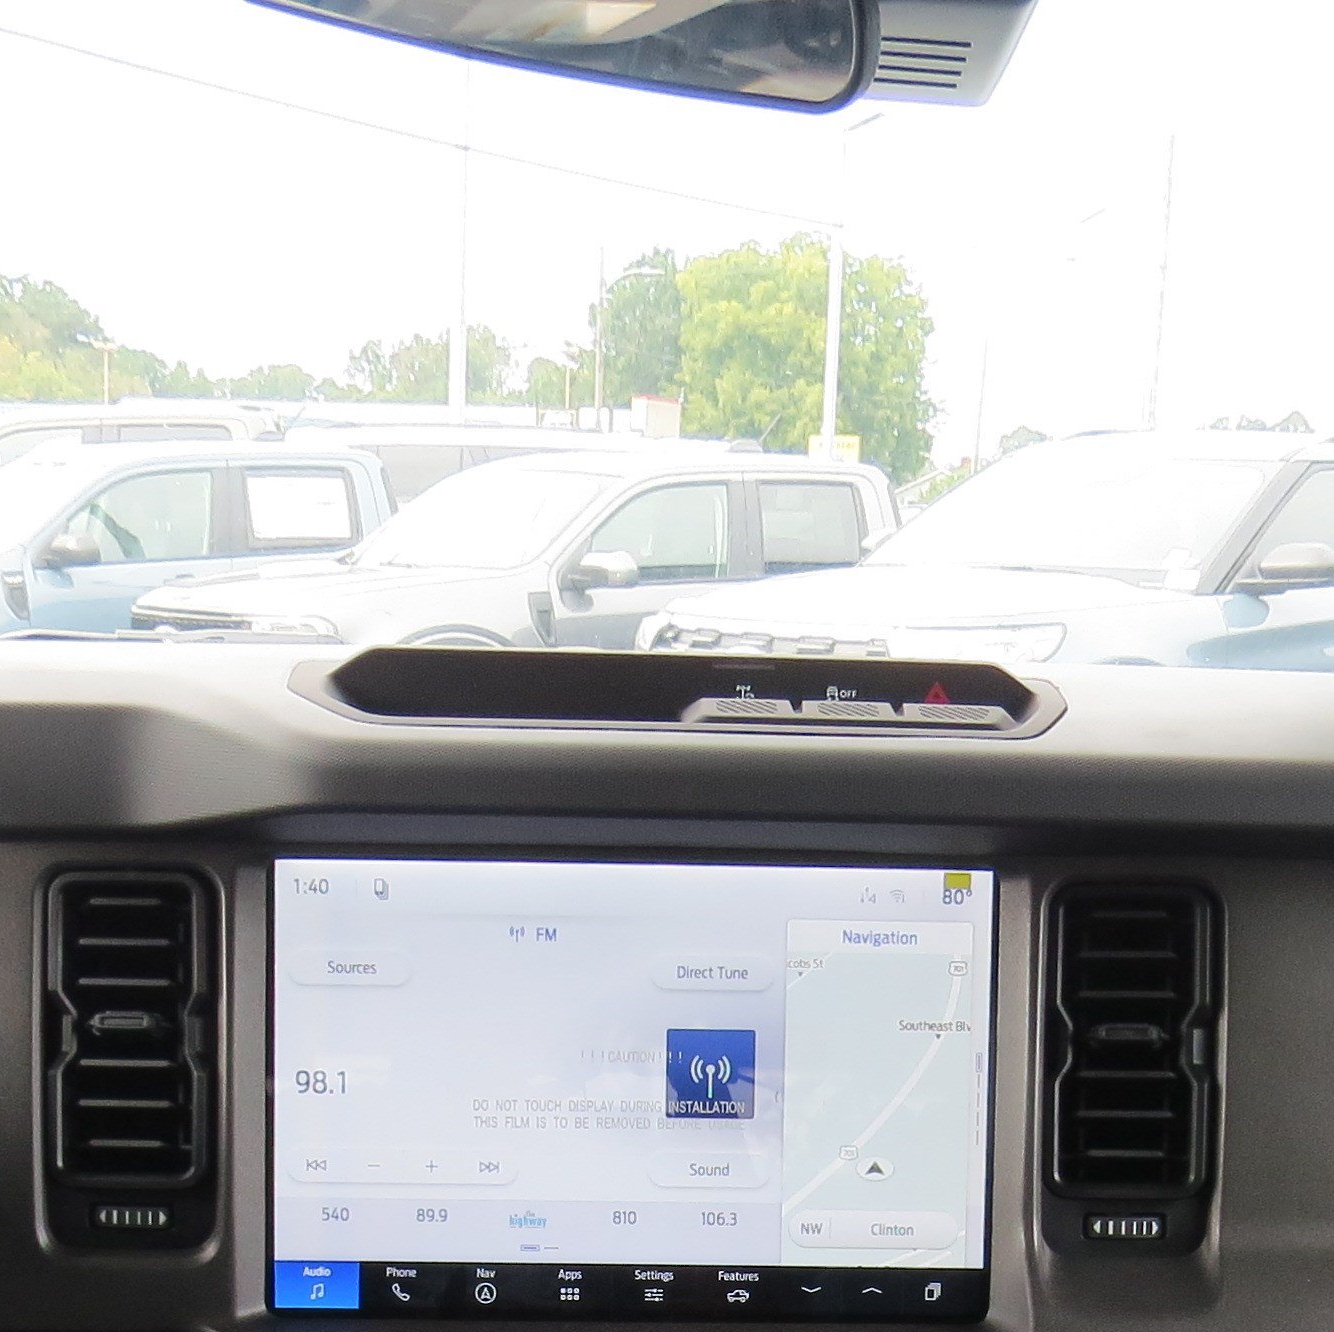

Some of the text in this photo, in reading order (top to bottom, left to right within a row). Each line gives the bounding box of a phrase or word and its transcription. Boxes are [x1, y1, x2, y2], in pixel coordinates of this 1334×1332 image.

[839, 690, 857, 699] OFF
[294, 878, 330, 895] 1:40
[942, 889, 972, 905] 80°
[536, 927, 558, 943] FM
[842, 929, 918, 947] Navigation
[327, 960, 377, 975] Sources
[787, 958, 811, 969] cobs
[677, 966, 749, 980] Direct Tune
[898, 1019, 953, 1032] Southeast
[295, 1071, 347, 1095] 98.1
[473, 1100, 746, 1114] DO NOT TOUCH DISPLAY DURING INSTALLATION
[474, 1116, 498, 1128] THIS
[504, 1116, 530, 1129] FILM
[536, 1116, 547, 1129] IS
[554, 1116, 568, 1129] TO
[575, 1116, 589, 1129] BE
[596, 1116, 651, 1129] REMOVED
[689, 1163, 730, 1177] Sound
[321, 1207, 350, 1222] 540
[416, 1208, 448, 1223] 89.9
[612, 1211, 637, 1225] 810
[700, 1211, 738, 1227] 106.3
[800, 1222, 823, 1235] NW
[871, 1222, 915, 1237] Clinton
[303, 1266, 331, 1277] Audio
[386, 1267, 417, 1278] Phone
[476, 1268, 496, 1279] Nav
[558, 1269, 583, 1282] Apps
[634, 1269, 674, 1282] Settings
[718, 1270, 759, 1282] Features
